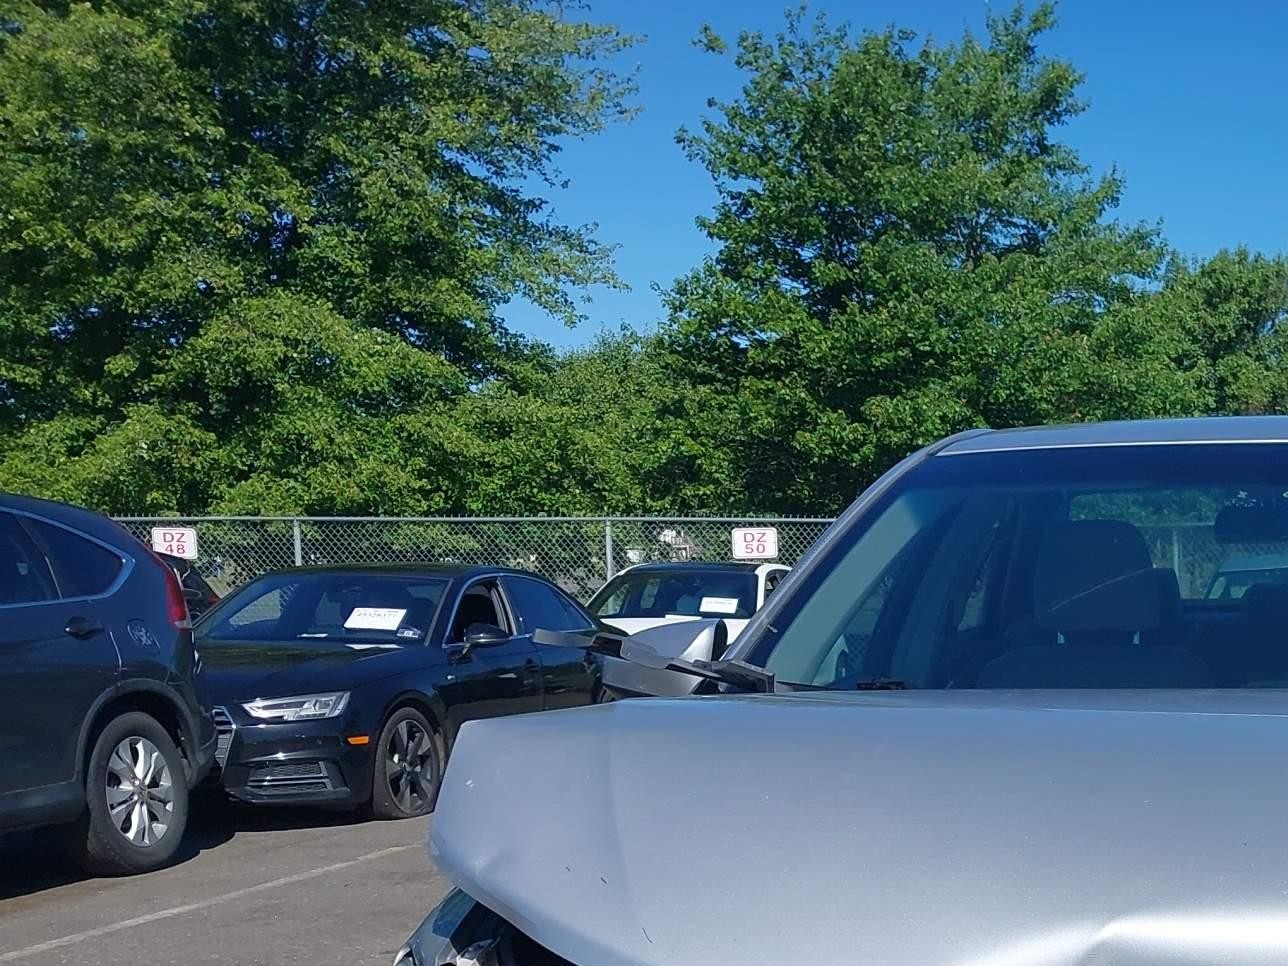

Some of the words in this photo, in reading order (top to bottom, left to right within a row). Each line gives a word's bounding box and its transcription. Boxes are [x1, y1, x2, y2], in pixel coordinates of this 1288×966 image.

[163, 532, 186, 543] DZ
[743, 532, 767, 543] DZ
[165, 544, 186, 554] 48
[745, 543, 766, 554] 50
